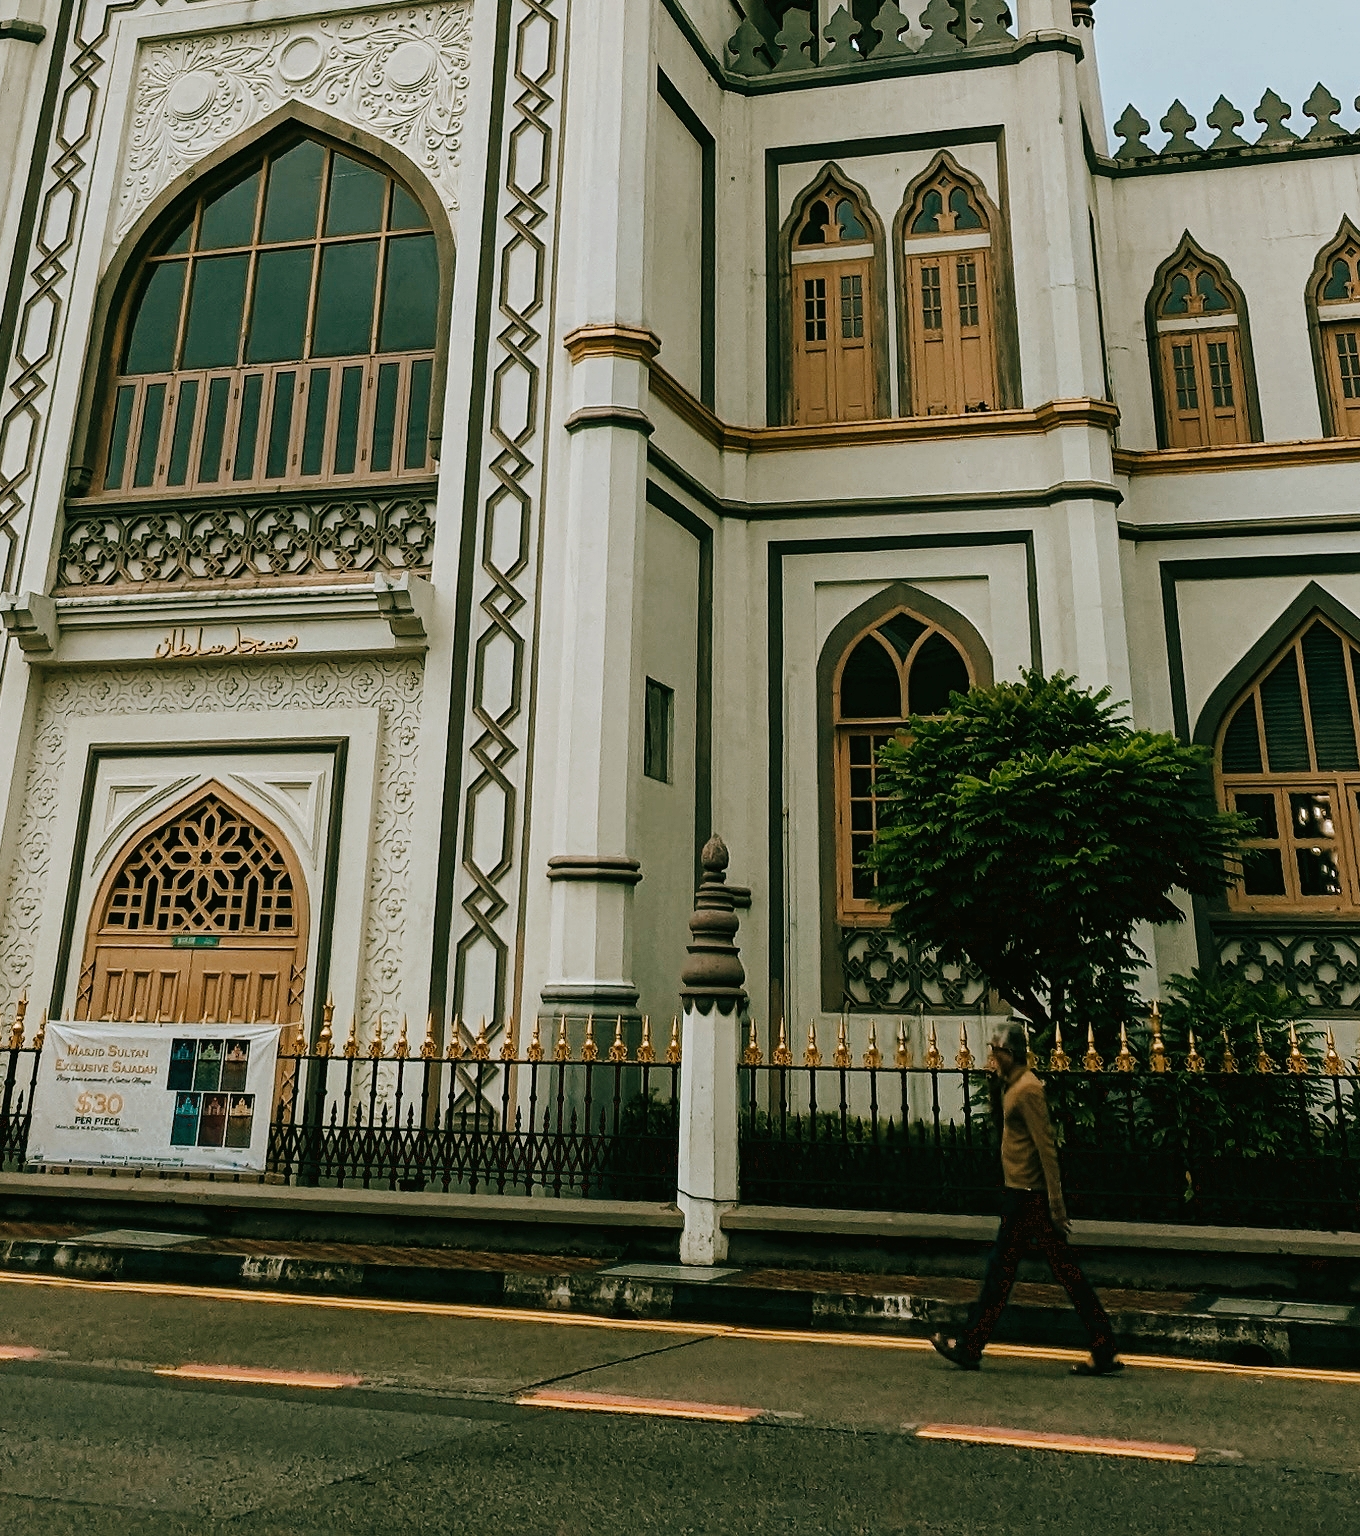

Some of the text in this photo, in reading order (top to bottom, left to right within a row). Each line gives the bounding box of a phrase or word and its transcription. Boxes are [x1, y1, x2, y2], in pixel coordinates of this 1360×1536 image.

[66, 1044, 149, 1058] MASJID SULTAN
[55, 1058, 158, 1075] EXCLUSIVE SAJADAH
[74, 1089, 124, 1116] $30
[74, 1116, 121, 1126] PER PIECE
